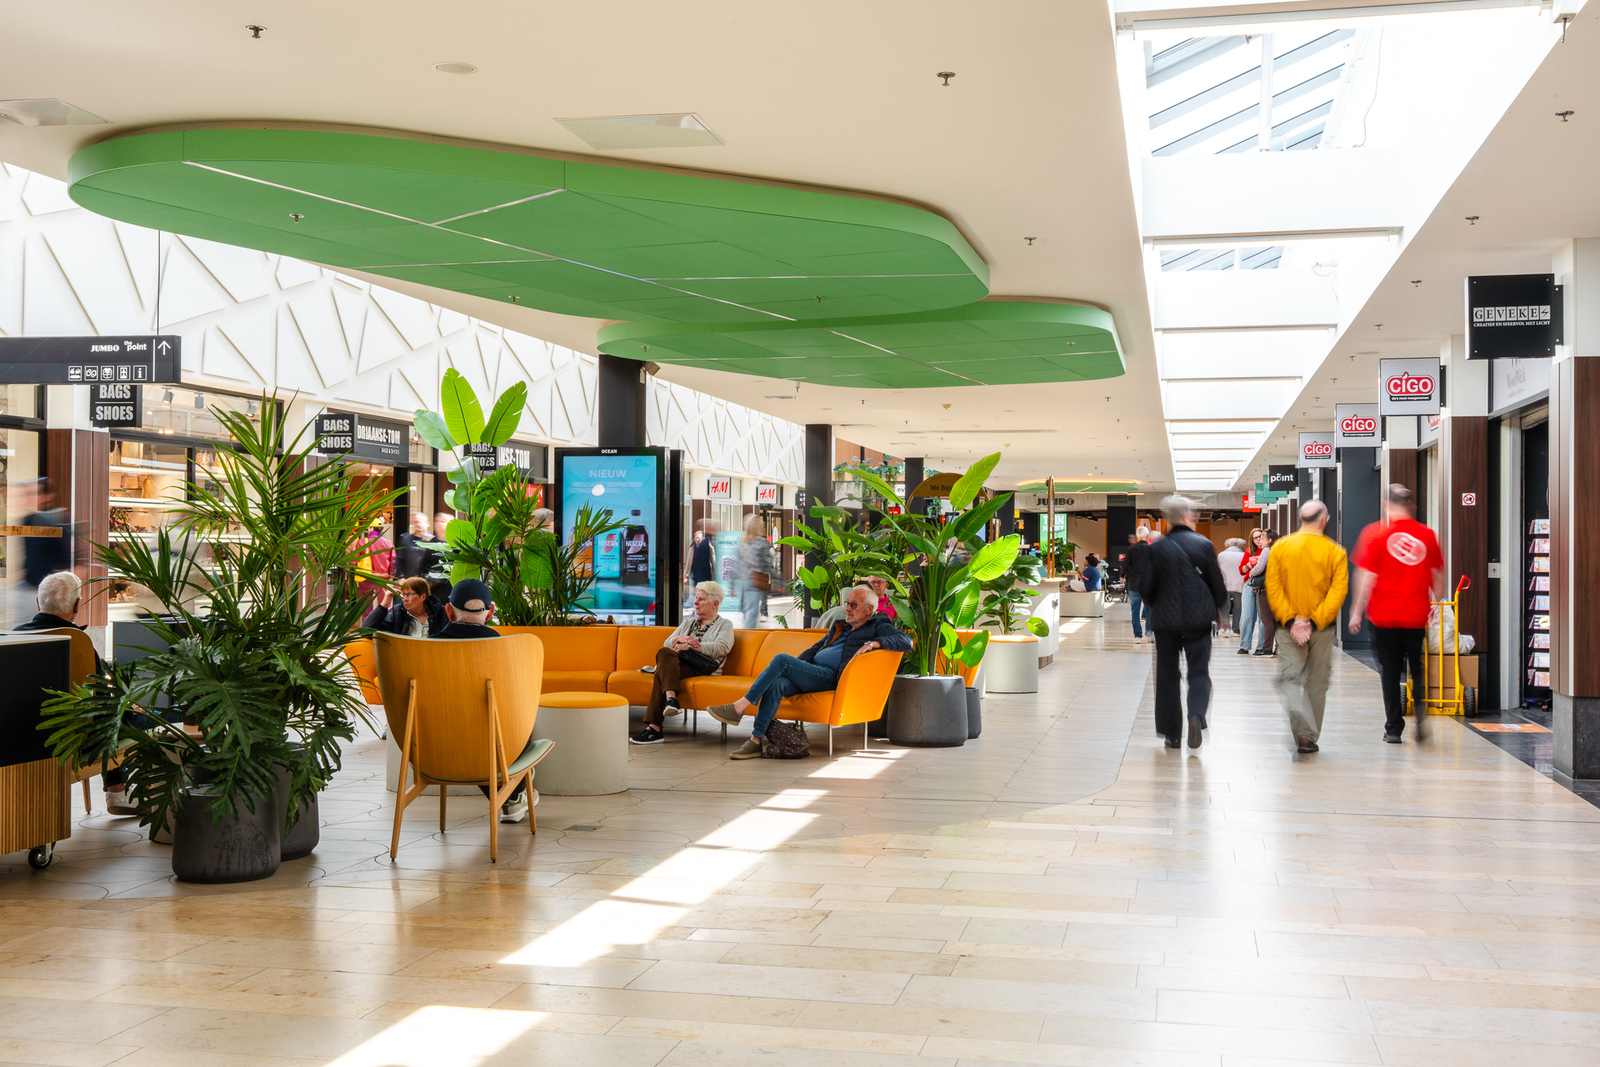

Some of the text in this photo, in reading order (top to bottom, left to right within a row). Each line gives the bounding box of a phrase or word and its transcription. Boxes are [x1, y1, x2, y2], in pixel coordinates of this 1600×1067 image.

[1474, 307, 1539, 320] GEVEKE
[126, 343, 148, 352] point
[99, 384, 131, 398] BAGS
[96, 406, 134, 420] SHOES
[323, 420, 350, 432] BAGS
[320, 436, 352, 448] SHOES
[590, 470, 626, 478] NIEUW
[711, 482, 728, 494] H&M
[760, 488, 776, 500] H&M
[1042, 515, 1064, 525] TIN
